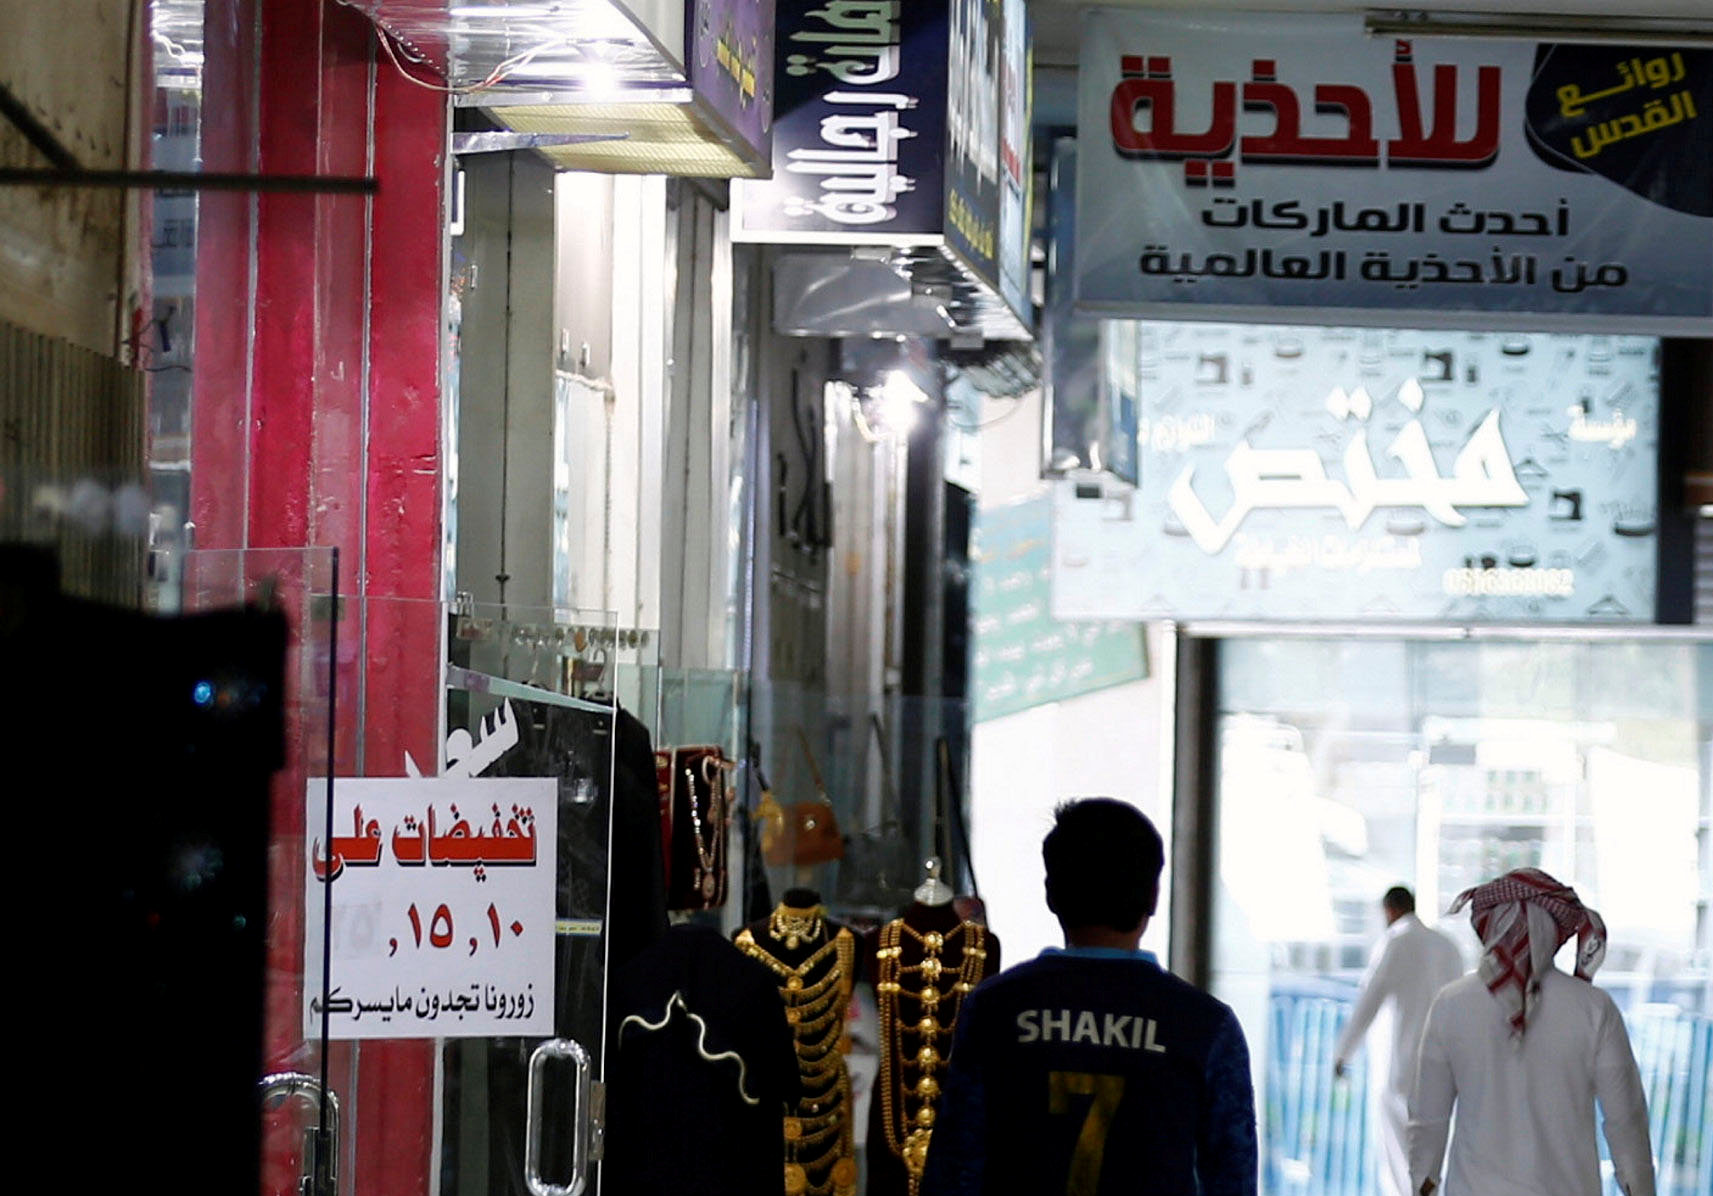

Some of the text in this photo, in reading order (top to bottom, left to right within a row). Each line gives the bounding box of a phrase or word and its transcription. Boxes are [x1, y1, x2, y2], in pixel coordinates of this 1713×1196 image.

[1110, 39, 1501, 187] للأحذية
[1570, 89, 1698, 159] القدس
[1201, 198, 1570, 237] أحدث الماركات
[1138, 244, 1630, 294] من الأحذية العالمية
[311, 802, 538, 884] تخفيضات على
[415, 984, 482, 1023] تجدون
[483, 983, 536, 1019] زورونا
[1015, 1008, 1168, 1054] SHAKIL
